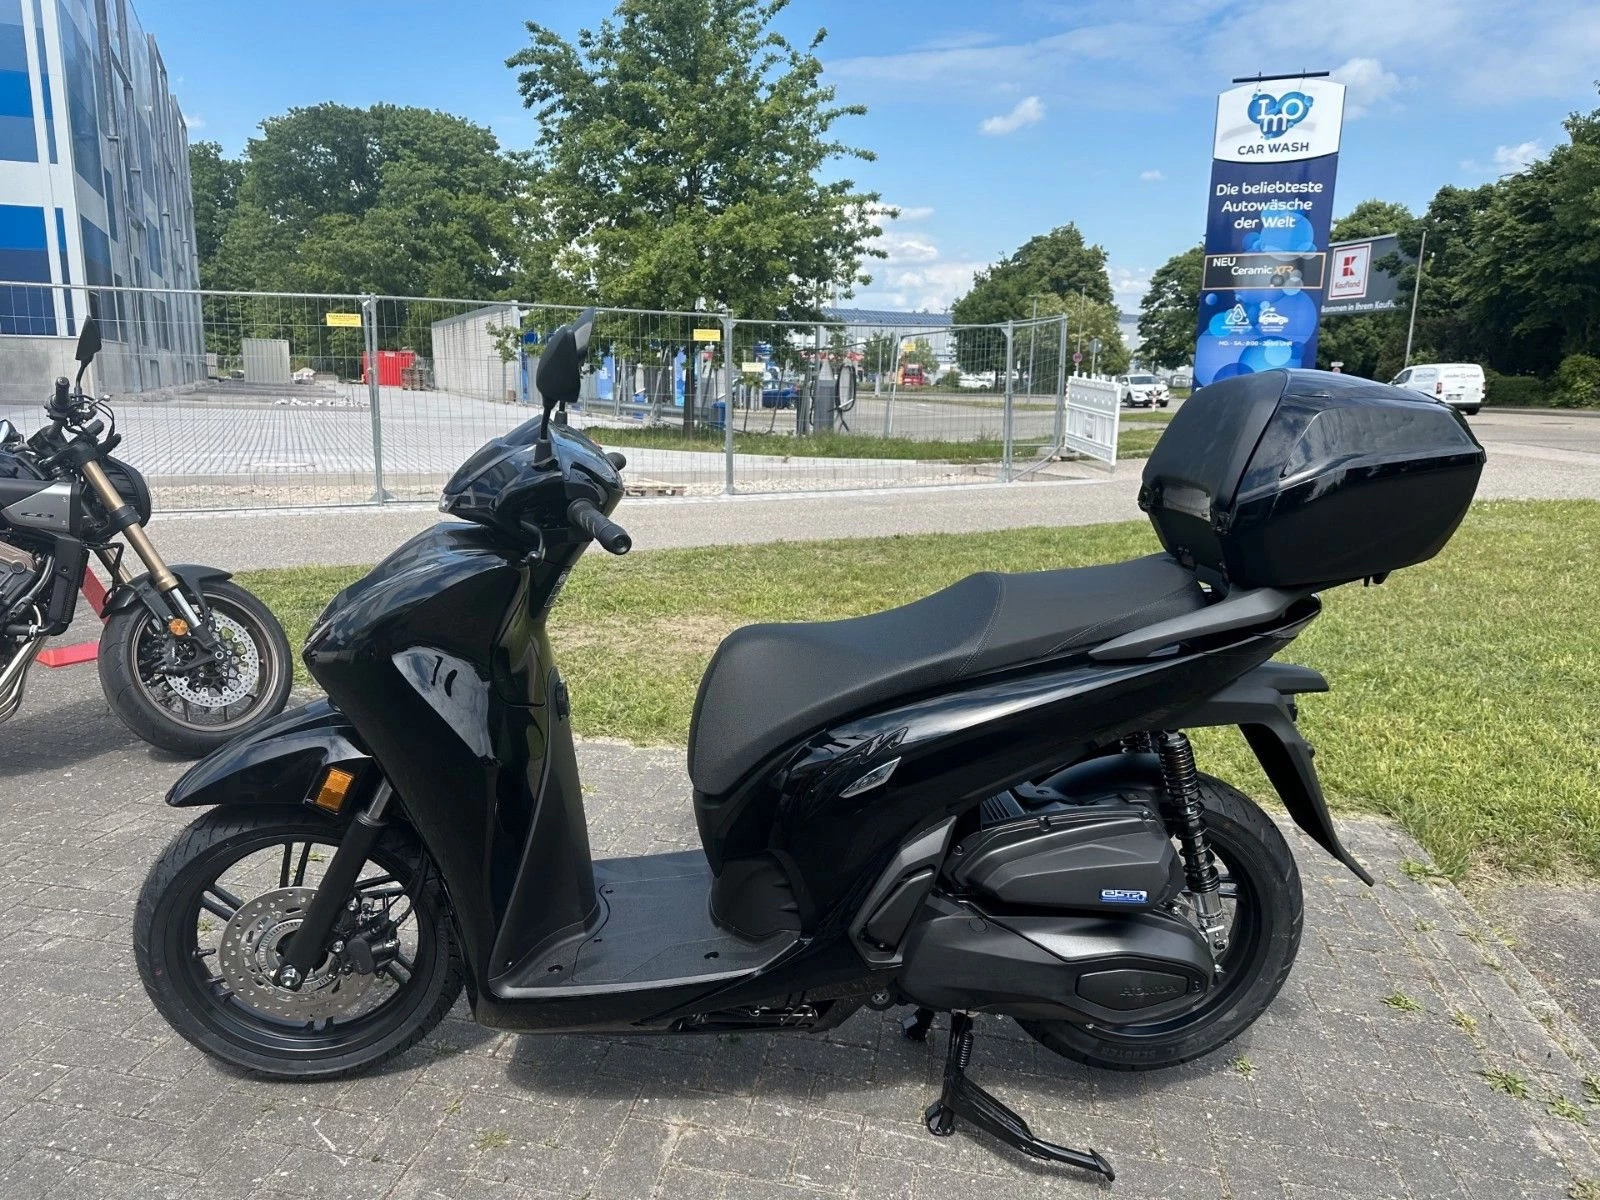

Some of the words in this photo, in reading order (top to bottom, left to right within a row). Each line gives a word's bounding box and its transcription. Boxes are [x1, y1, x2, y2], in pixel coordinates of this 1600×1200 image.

[1237, 145, 1265, 155] CAR
[1268, 142, 1310, 153] WASH
[1216, 184, 1239, 196] Die
[1242, 181, 1324, 195] beliebteste
[1221, 198, 1313, 213] Autowäsche
[1234, 217, 1259, 229] der
[1261, 216, 1296, 228] Welt
[1212, 257, 1236, 267] NEU
[1231, 265, 1273, 276] Ceramic
[1335, 280, 1361, 289] Kaufland
[1348, 303, 1354, 311] in
[1355, 302, 1374, 311] Ihrem
